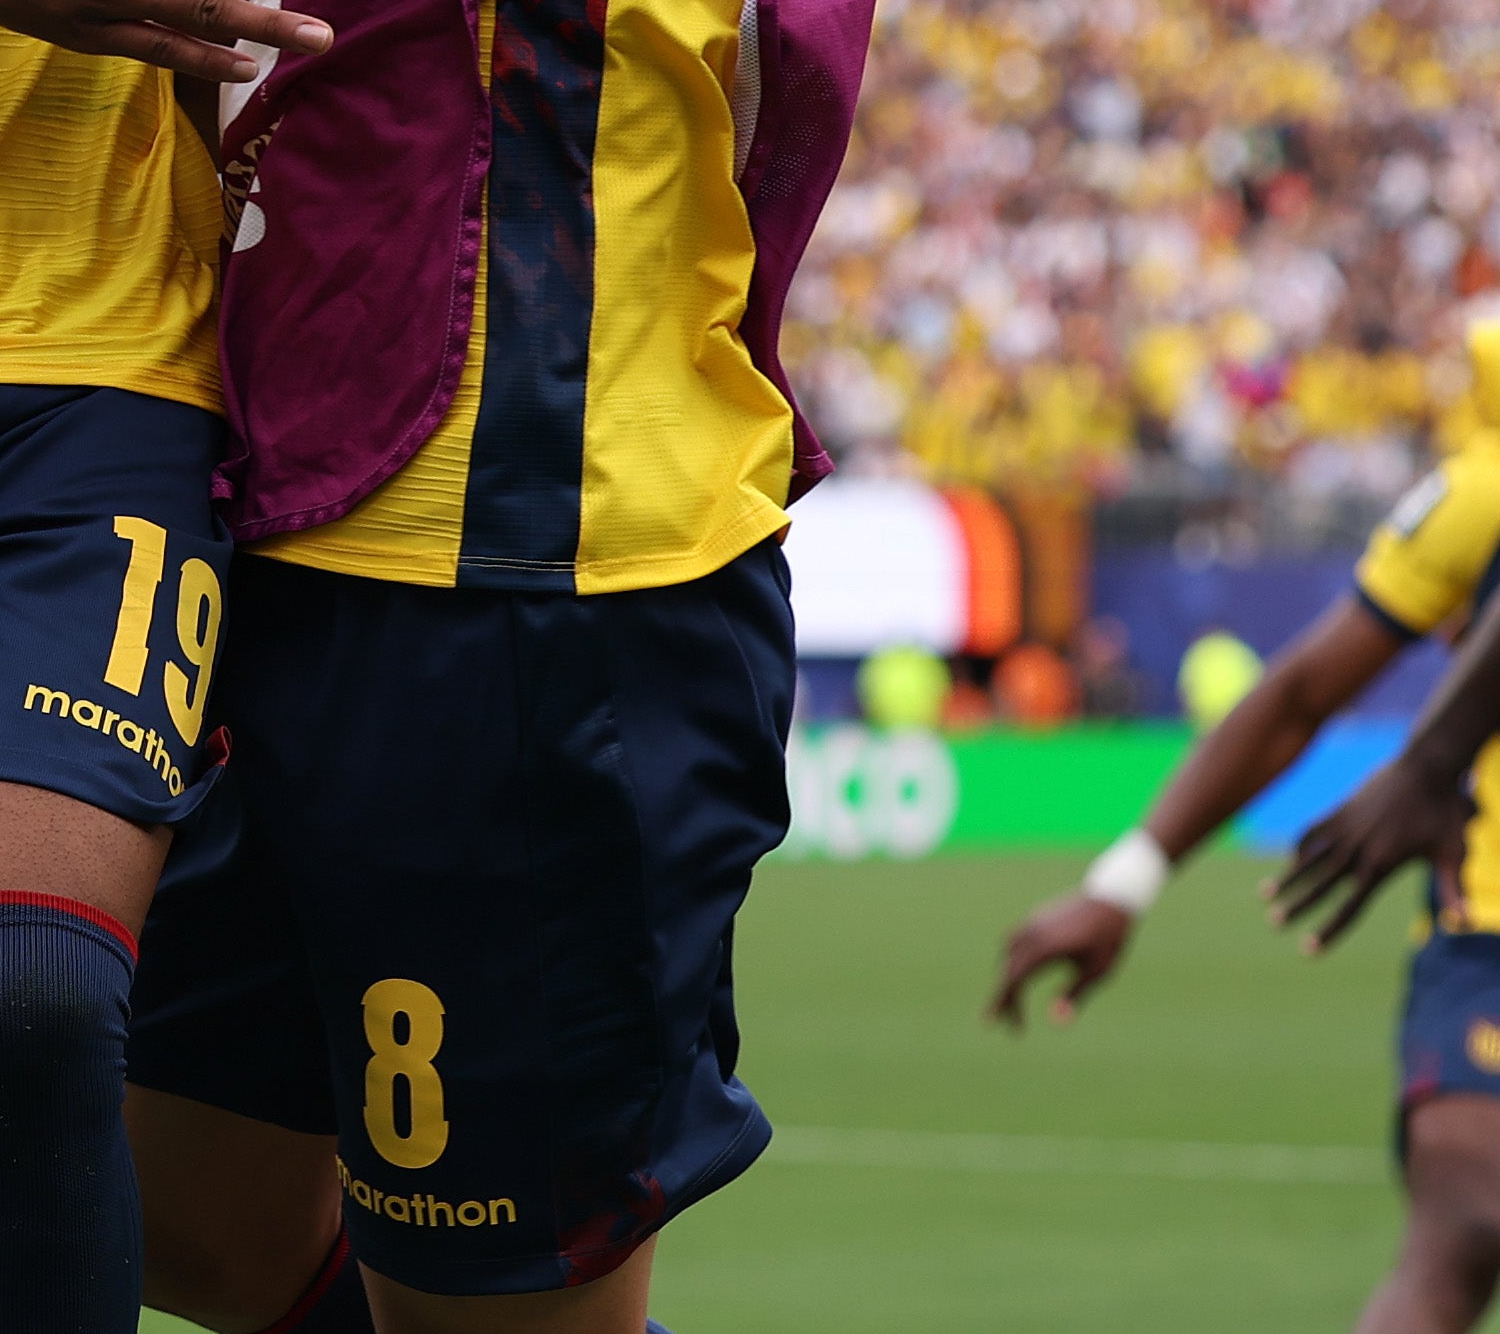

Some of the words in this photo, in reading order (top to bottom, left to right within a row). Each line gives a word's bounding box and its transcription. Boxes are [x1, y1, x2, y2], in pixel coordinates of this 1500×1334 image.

[104, 515, 222, 747] 19
[23, 683, 185, 797] maratho
[361, 978, 449, 1169] 8
